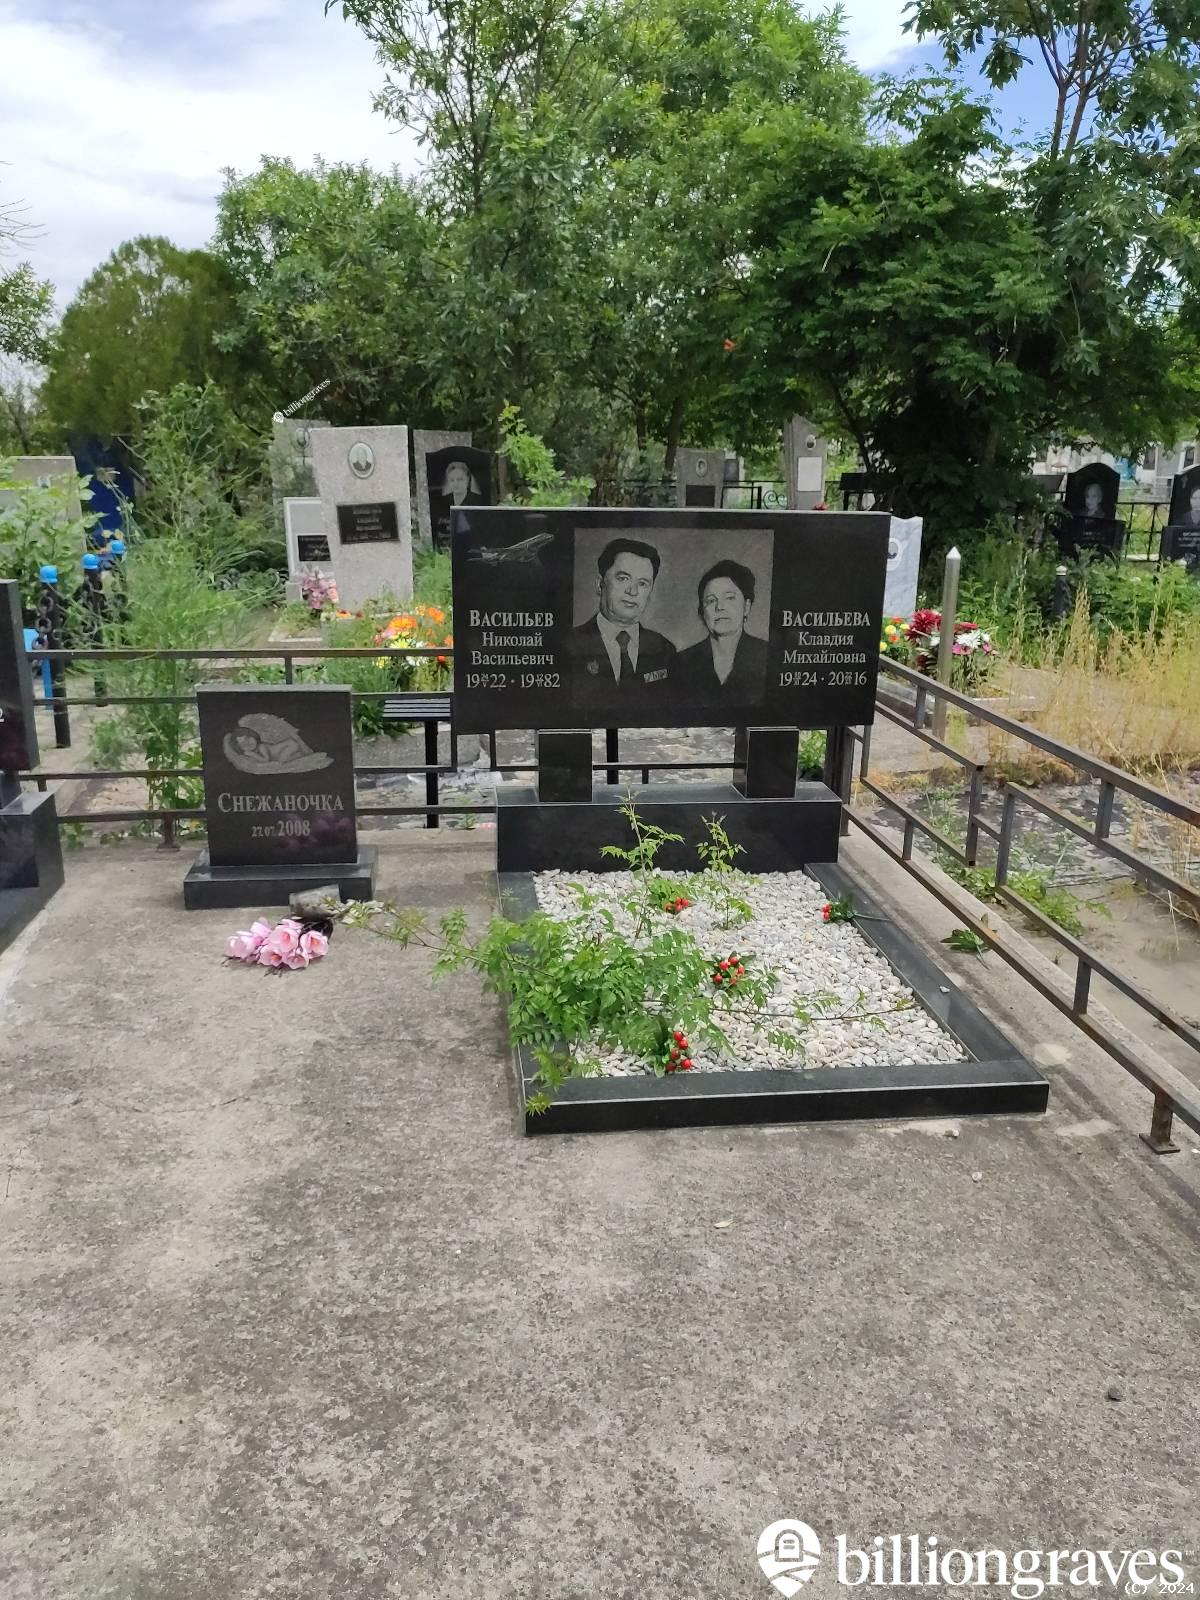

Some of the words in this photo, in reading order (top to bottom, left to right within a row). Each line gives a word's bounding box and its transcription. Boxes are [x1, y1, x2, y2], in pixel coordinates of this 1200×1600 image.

[482, 631, 543, 647] Николай
[798, 631, 854, 647] Клавдия
[471, 650, 554, 665] Васильевич
[783, 649, 866, 664] Михайловна
